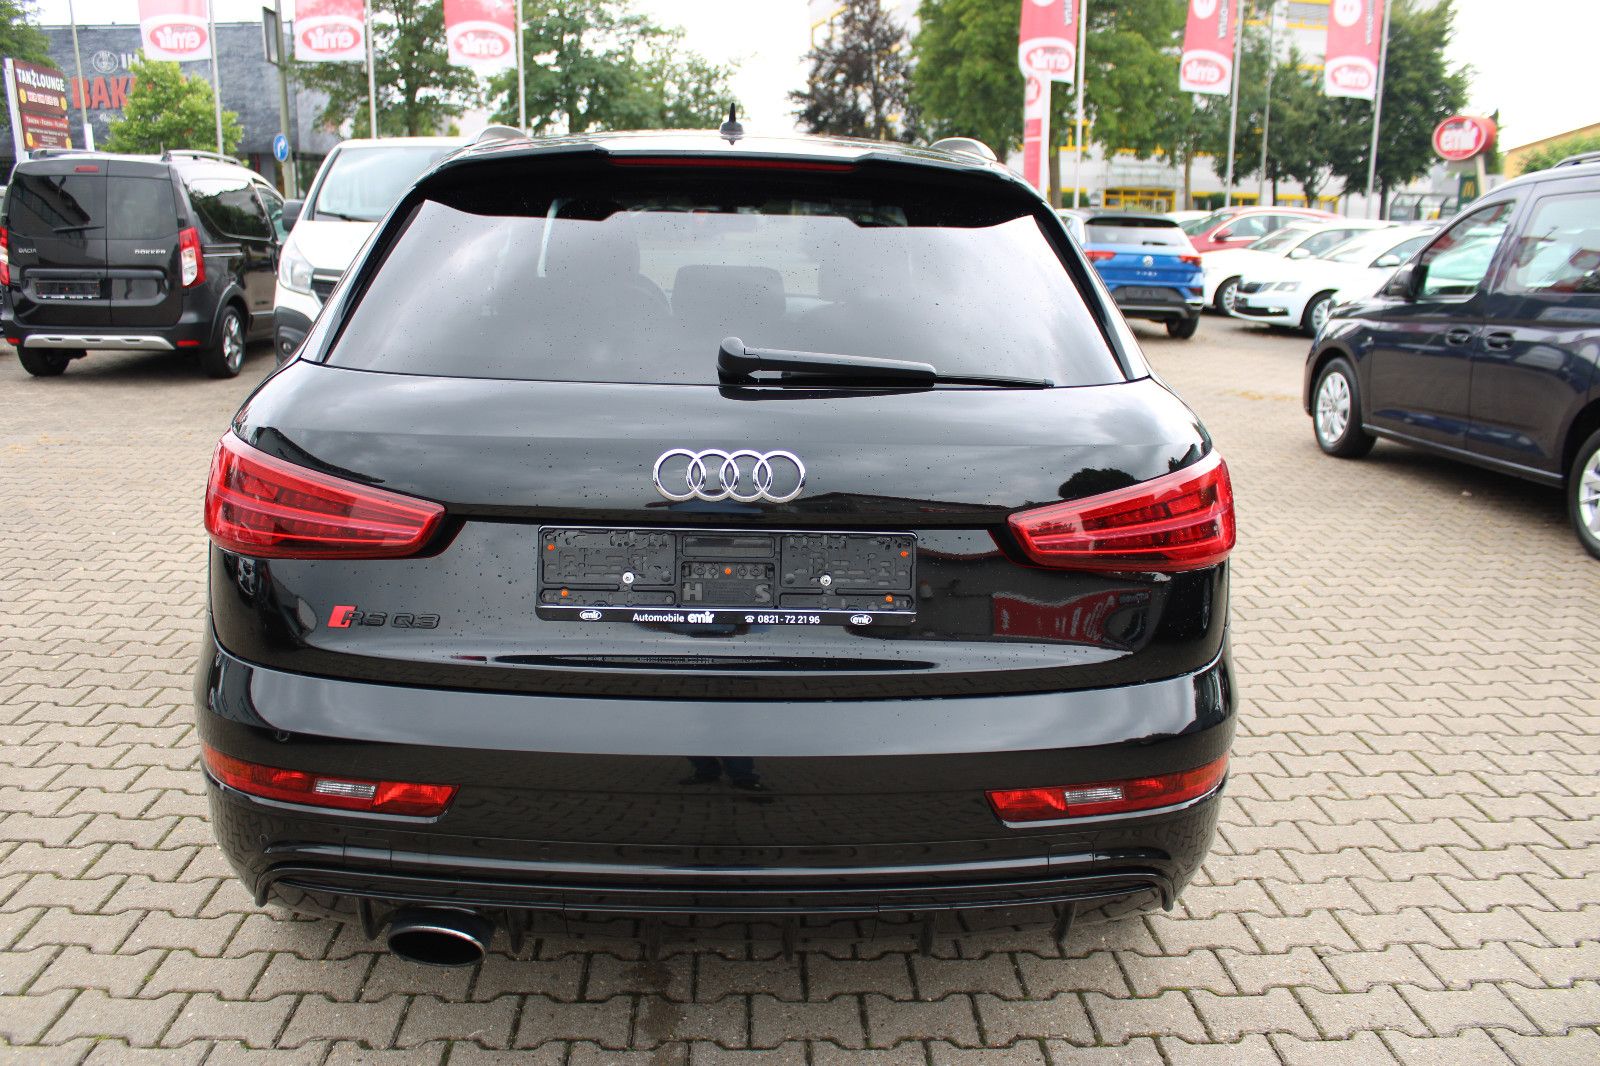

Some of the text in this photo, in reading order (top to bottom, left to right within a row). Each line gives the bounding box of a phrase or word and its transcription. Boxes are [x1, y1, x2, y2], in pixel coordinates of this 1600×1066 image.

[15, 68, 65, 92] TANZLOUNGE
[1441, 120, 1478, 151] emir
[683, 582, 704, 601] H
[755, 583, 772, 603] S
[341, 611, 440, 629] RS Q3
[581, 610, 599, 619] emir
[632, 610, 715, 624] Automobile emir
[757, 614, 779, 624] 0821
[785, 615, 796, 624] 72
[853, 614, 870, 624] emir
